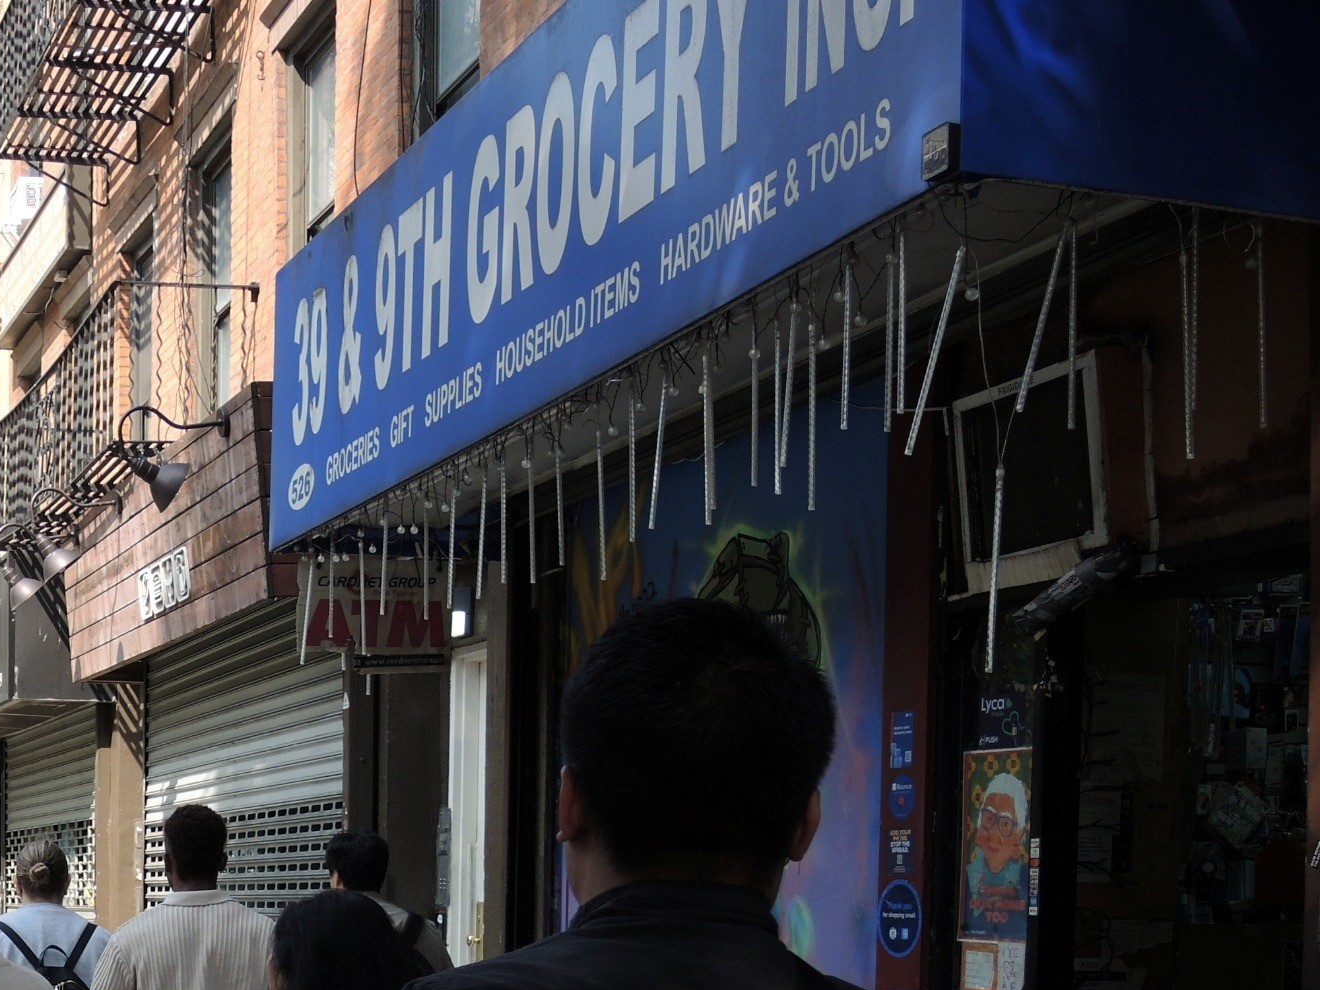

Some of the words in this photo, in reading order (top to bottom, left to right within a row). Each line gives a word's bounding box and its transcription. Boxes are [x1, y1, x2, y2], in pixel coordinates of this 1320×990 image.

[292, 287, 327, 446] 39
[338, 254, 362, 414] &
[373, 170, 454, 390] 9TH
[466, 0, 746, 324] GROCERY
[326, 427, 380, 486] GROCERIES
[390, 405, 415, 448] GIFT
[424, 361, 483, 428] SUPPLIES
[495, 296, 586, 385] HOUSEHOLD
[589, 261, 641, 329] ITEMS
[659, 169, 778, 285] HARDWARE
[783, 157, 800, 207] &
[807, 98, 891, 192] TOOLS
[291, 470, 311, 505] 526
[388, 577, 437, 589] GROUP
[305, 598, 446, 648] ATM
[981, 698, 1005, 713] Lyca
